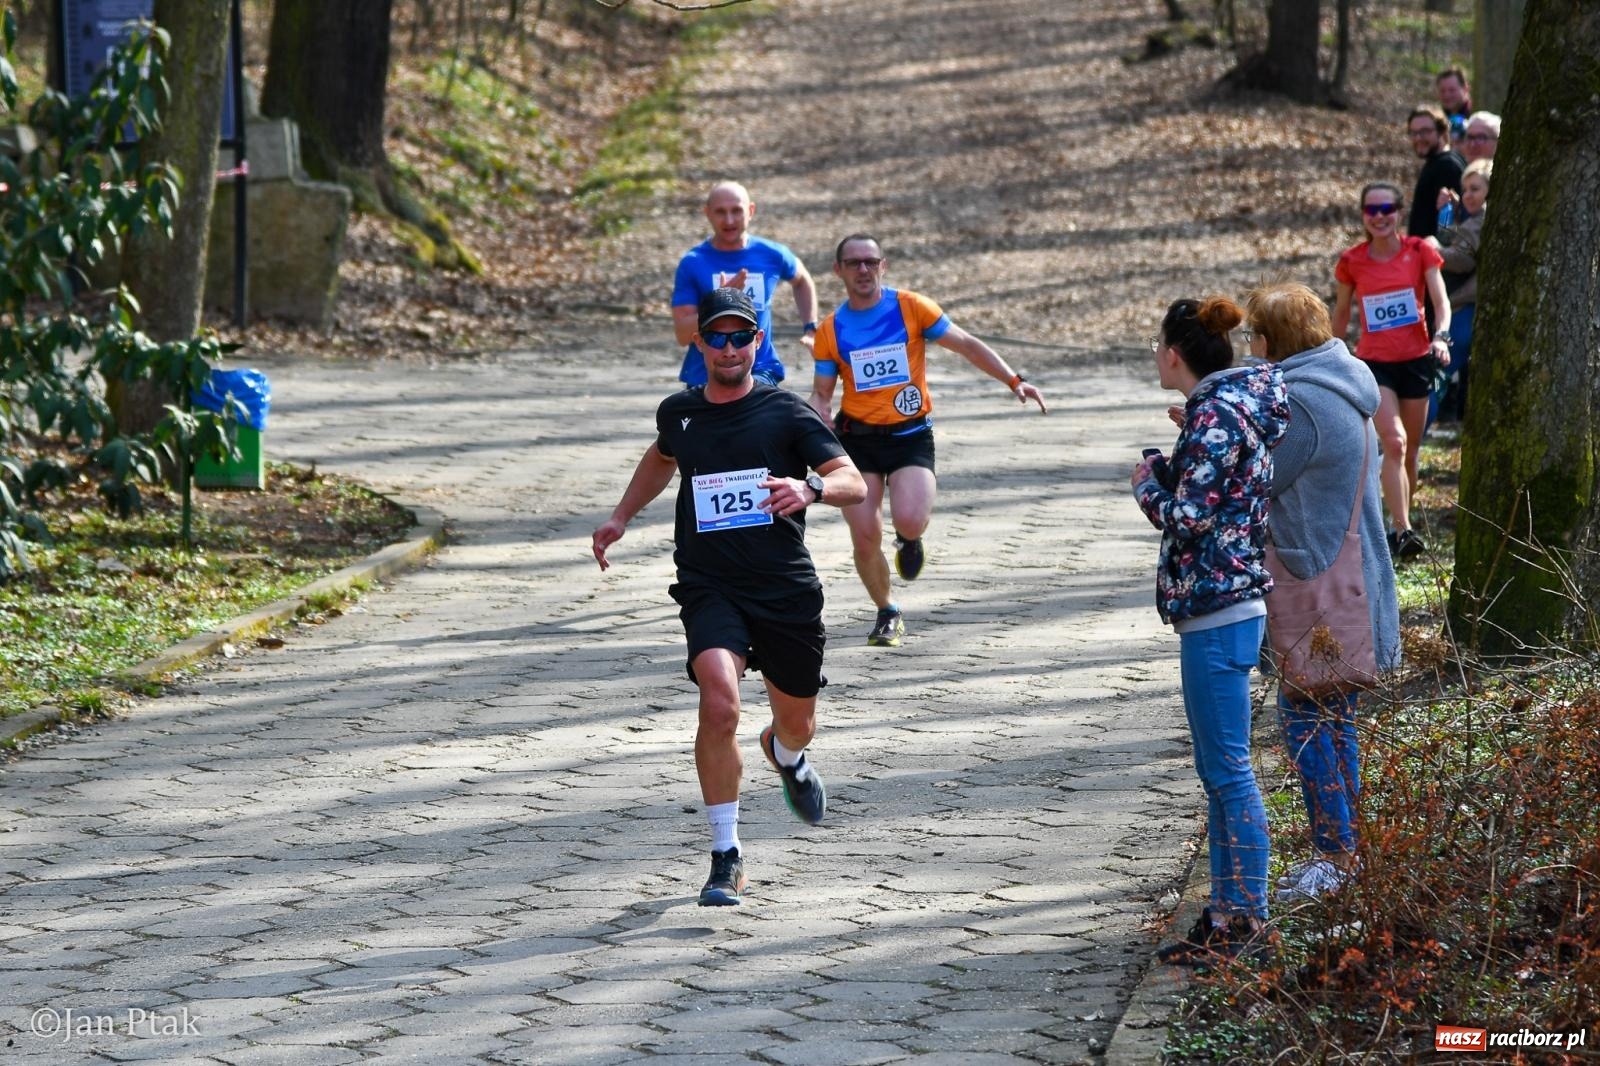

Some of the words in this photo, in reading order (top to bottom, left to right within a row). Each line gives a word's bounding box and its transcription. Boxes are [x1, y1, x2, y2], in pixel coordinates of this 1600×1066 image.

[1375, 303, 1407, 320] 063
[863, 359, 898, 378] 032
[899, 389, 920, 412] 悟
[710, 490, 753, 514] 125
